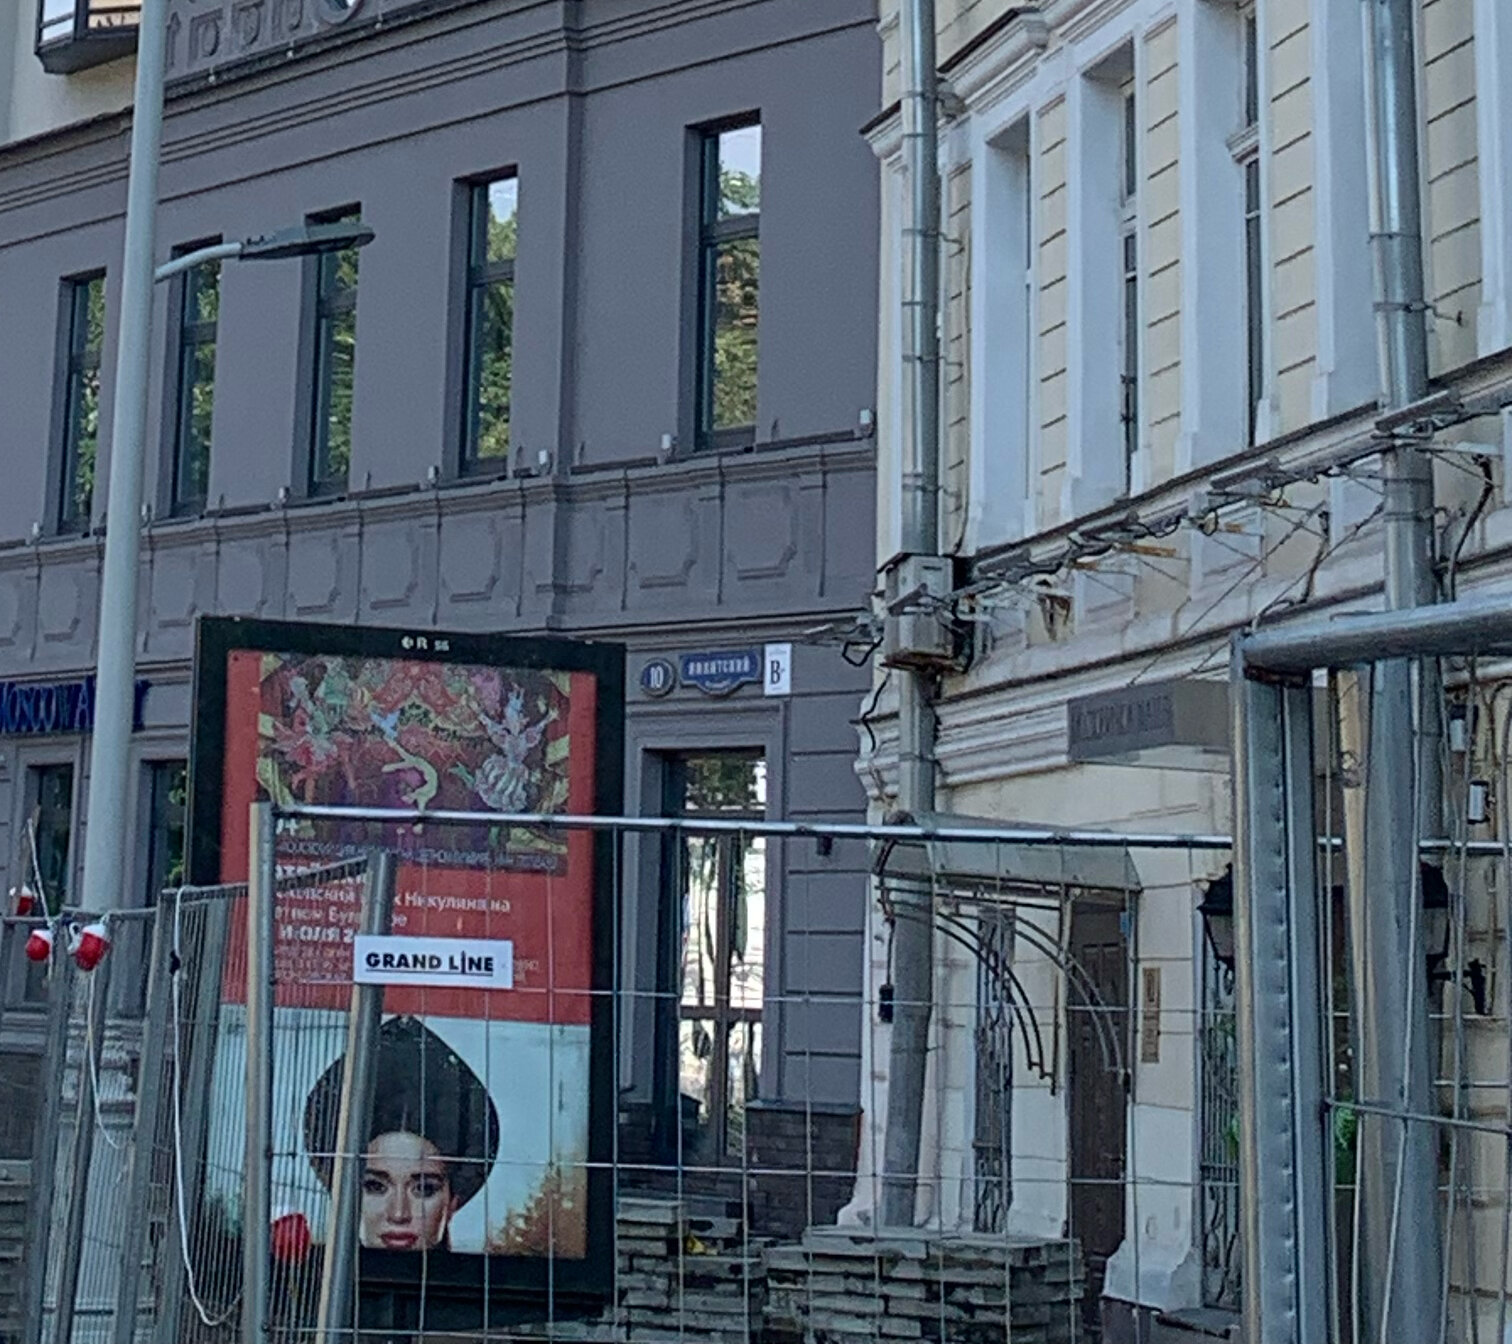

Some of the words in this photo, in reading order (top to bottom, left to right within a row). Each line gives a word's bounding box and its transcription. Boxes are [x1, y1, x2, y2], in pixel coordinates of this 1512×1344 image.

[649, 665, 665, 689] 10
[365, 951, 442, 970] GRAND
[448, 950, 494, 974] LINE
